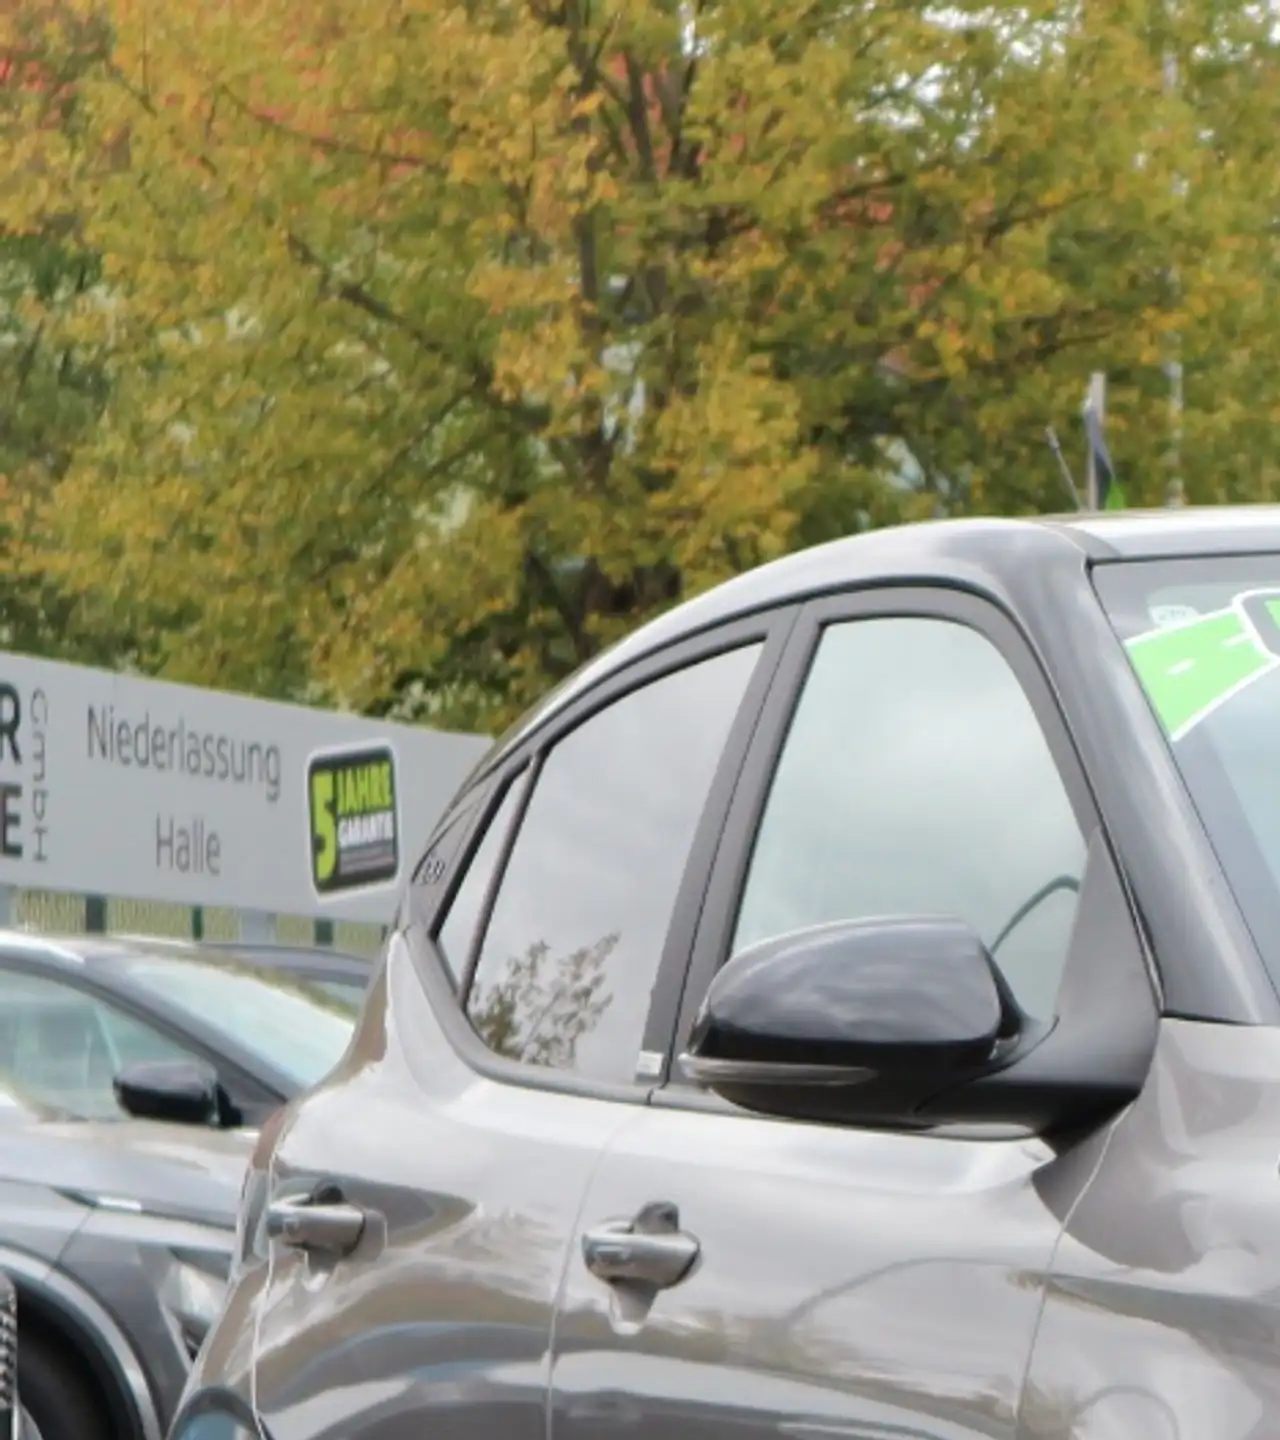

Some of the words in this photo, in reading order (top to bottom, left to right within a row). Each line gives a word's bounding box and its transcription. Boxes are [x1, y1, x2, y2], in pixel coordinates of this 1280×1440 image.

[87, 703, 282, 803] Niederlassung
[155, 812, 222, 877] Halle
[312, 769, 337, 883] 5
